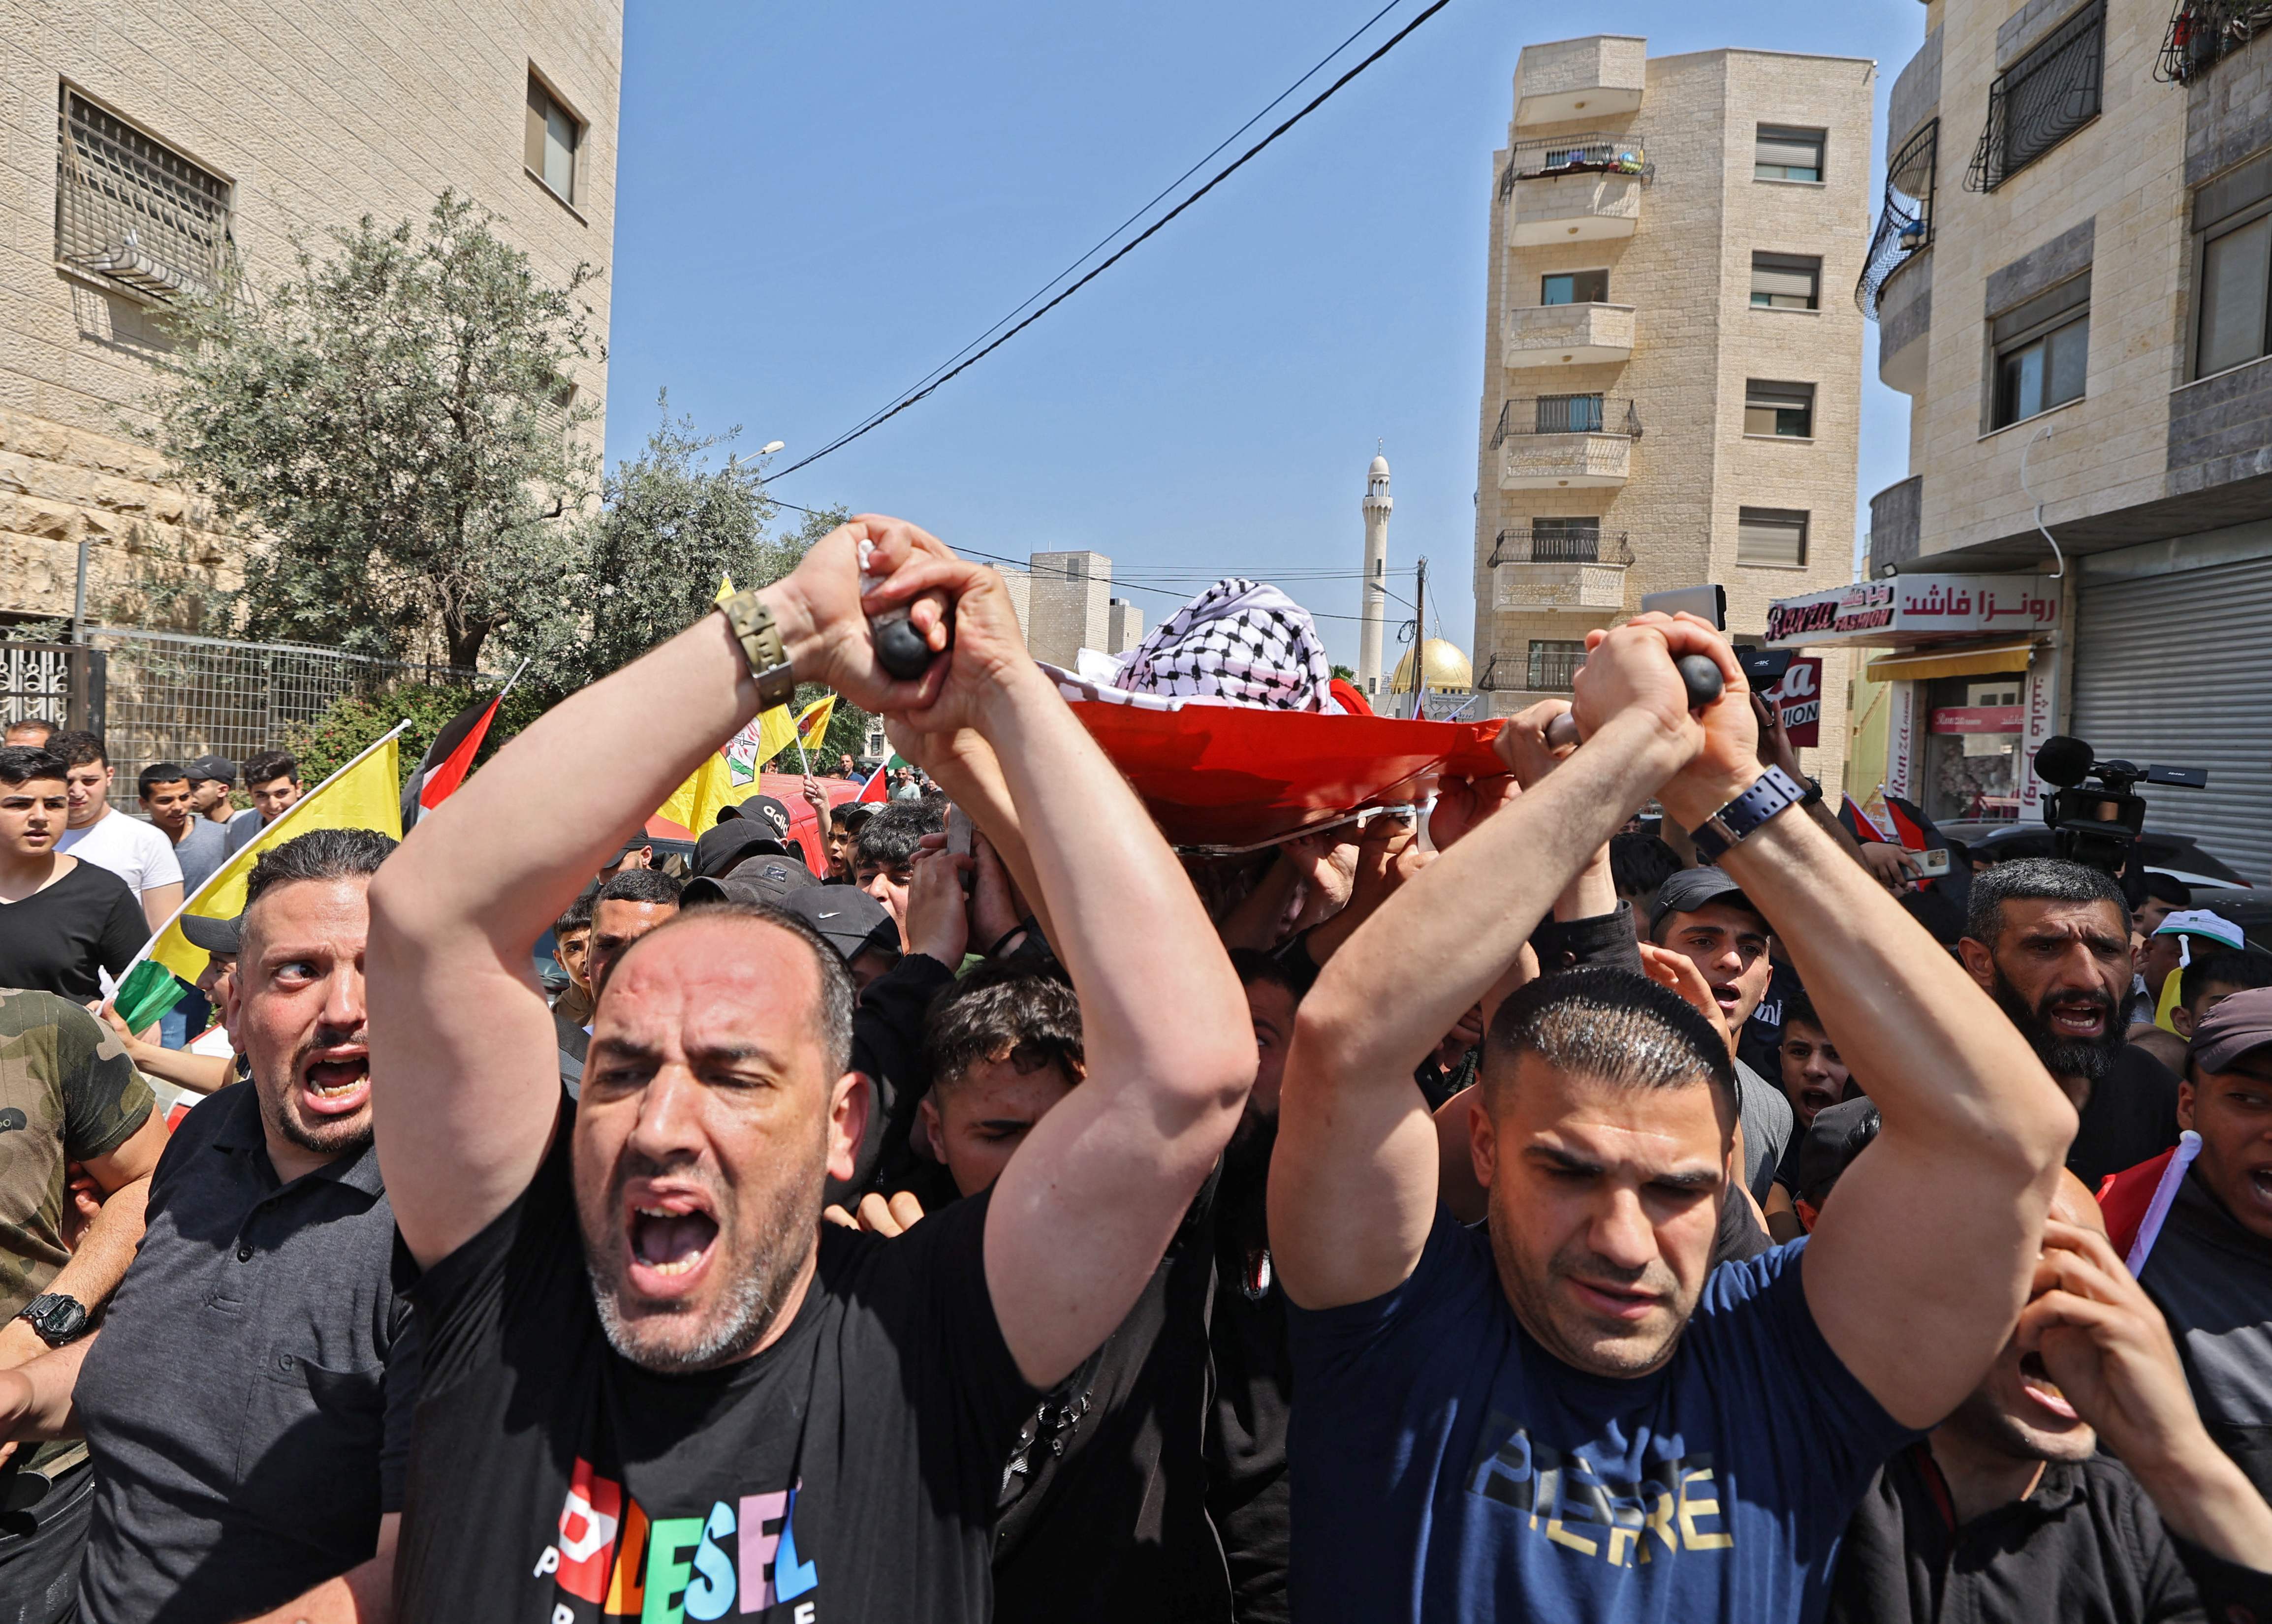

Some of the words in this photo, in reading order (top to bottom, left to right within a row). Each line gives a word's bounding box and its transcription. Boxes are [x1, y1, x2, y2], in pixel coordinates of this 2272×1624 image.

[1902, 584, 1971, 615] فاشن
[1978, 590, 2056, 622] رونزا
[1834, 609, 1892, 631] FASHION
